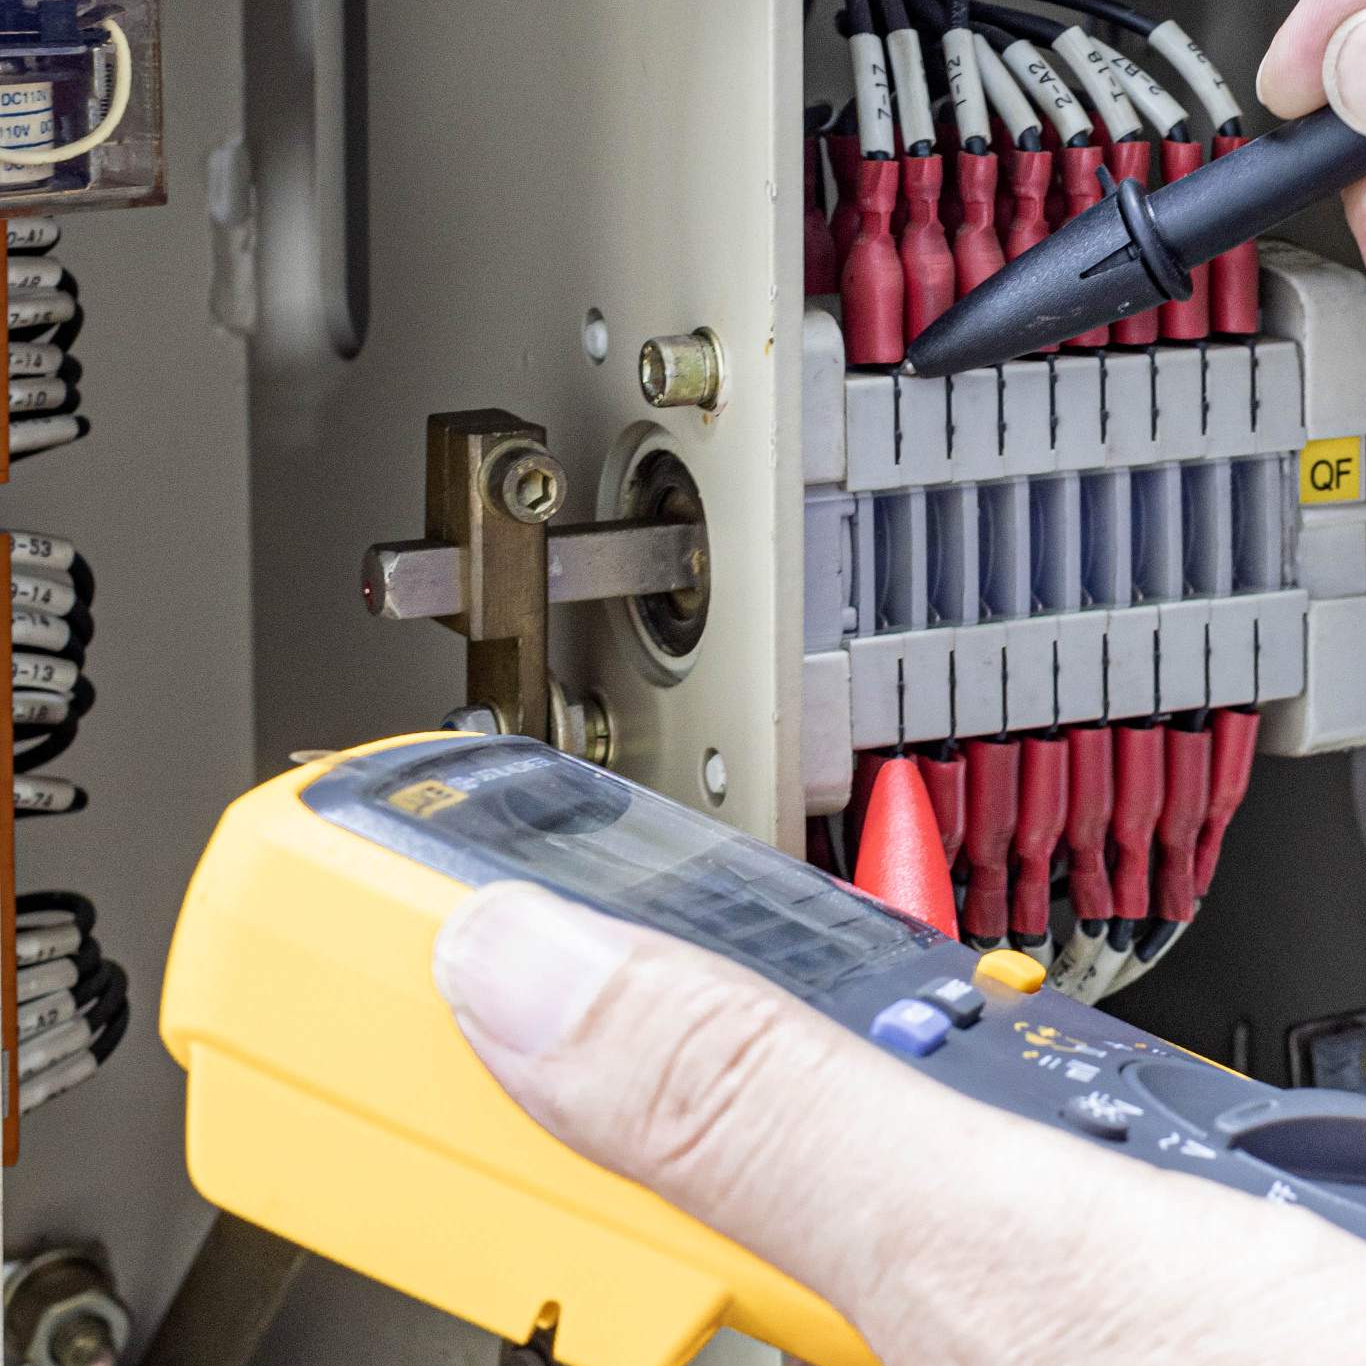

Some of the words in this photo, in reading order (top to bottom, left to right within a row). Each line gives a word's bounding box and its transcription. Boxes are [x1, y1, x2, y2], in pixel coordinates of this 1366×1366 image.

[871, 63, 893, 121] 7-17
[1028, 59, 1073, 109] 2-A2
[1310, 457, 1352, 492] QF
